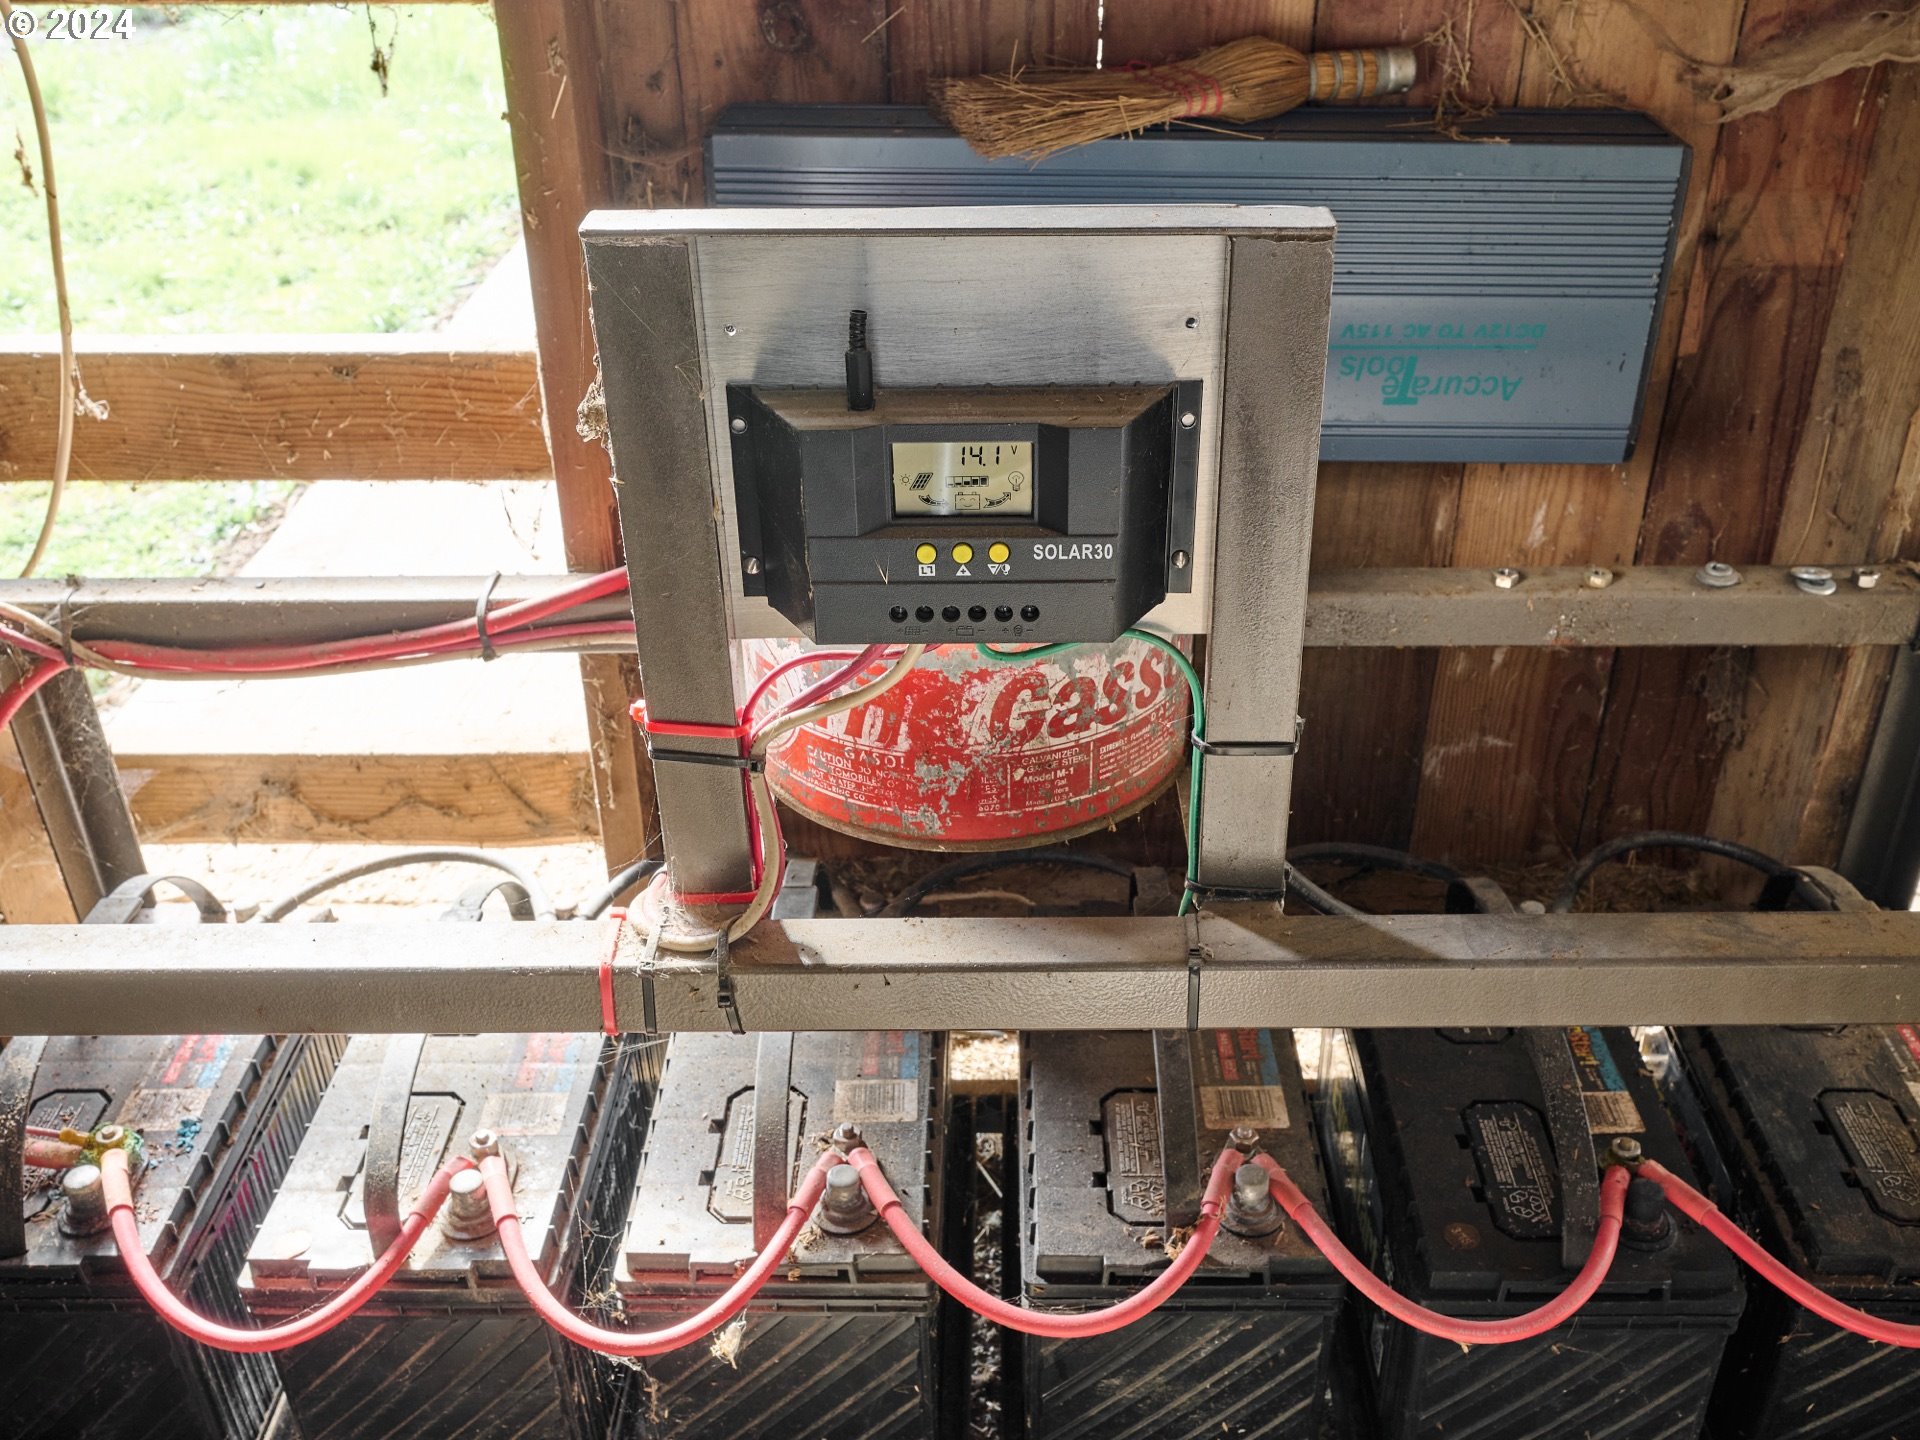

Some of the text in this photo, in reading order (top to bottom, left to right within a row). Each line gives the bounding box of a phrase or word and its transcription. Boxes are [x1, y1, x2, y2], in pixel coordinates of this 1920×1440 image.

[1341, 323, 1547, 339] DC12V TO AC 115V
[961, 445, 1018, 467] 14.1 V
[1033, 543, 1113, 560] SOLAR30
[1021, 747, 1080, 766] GALVANIZED
[1023, 766, 1075, 784] Model M-1
